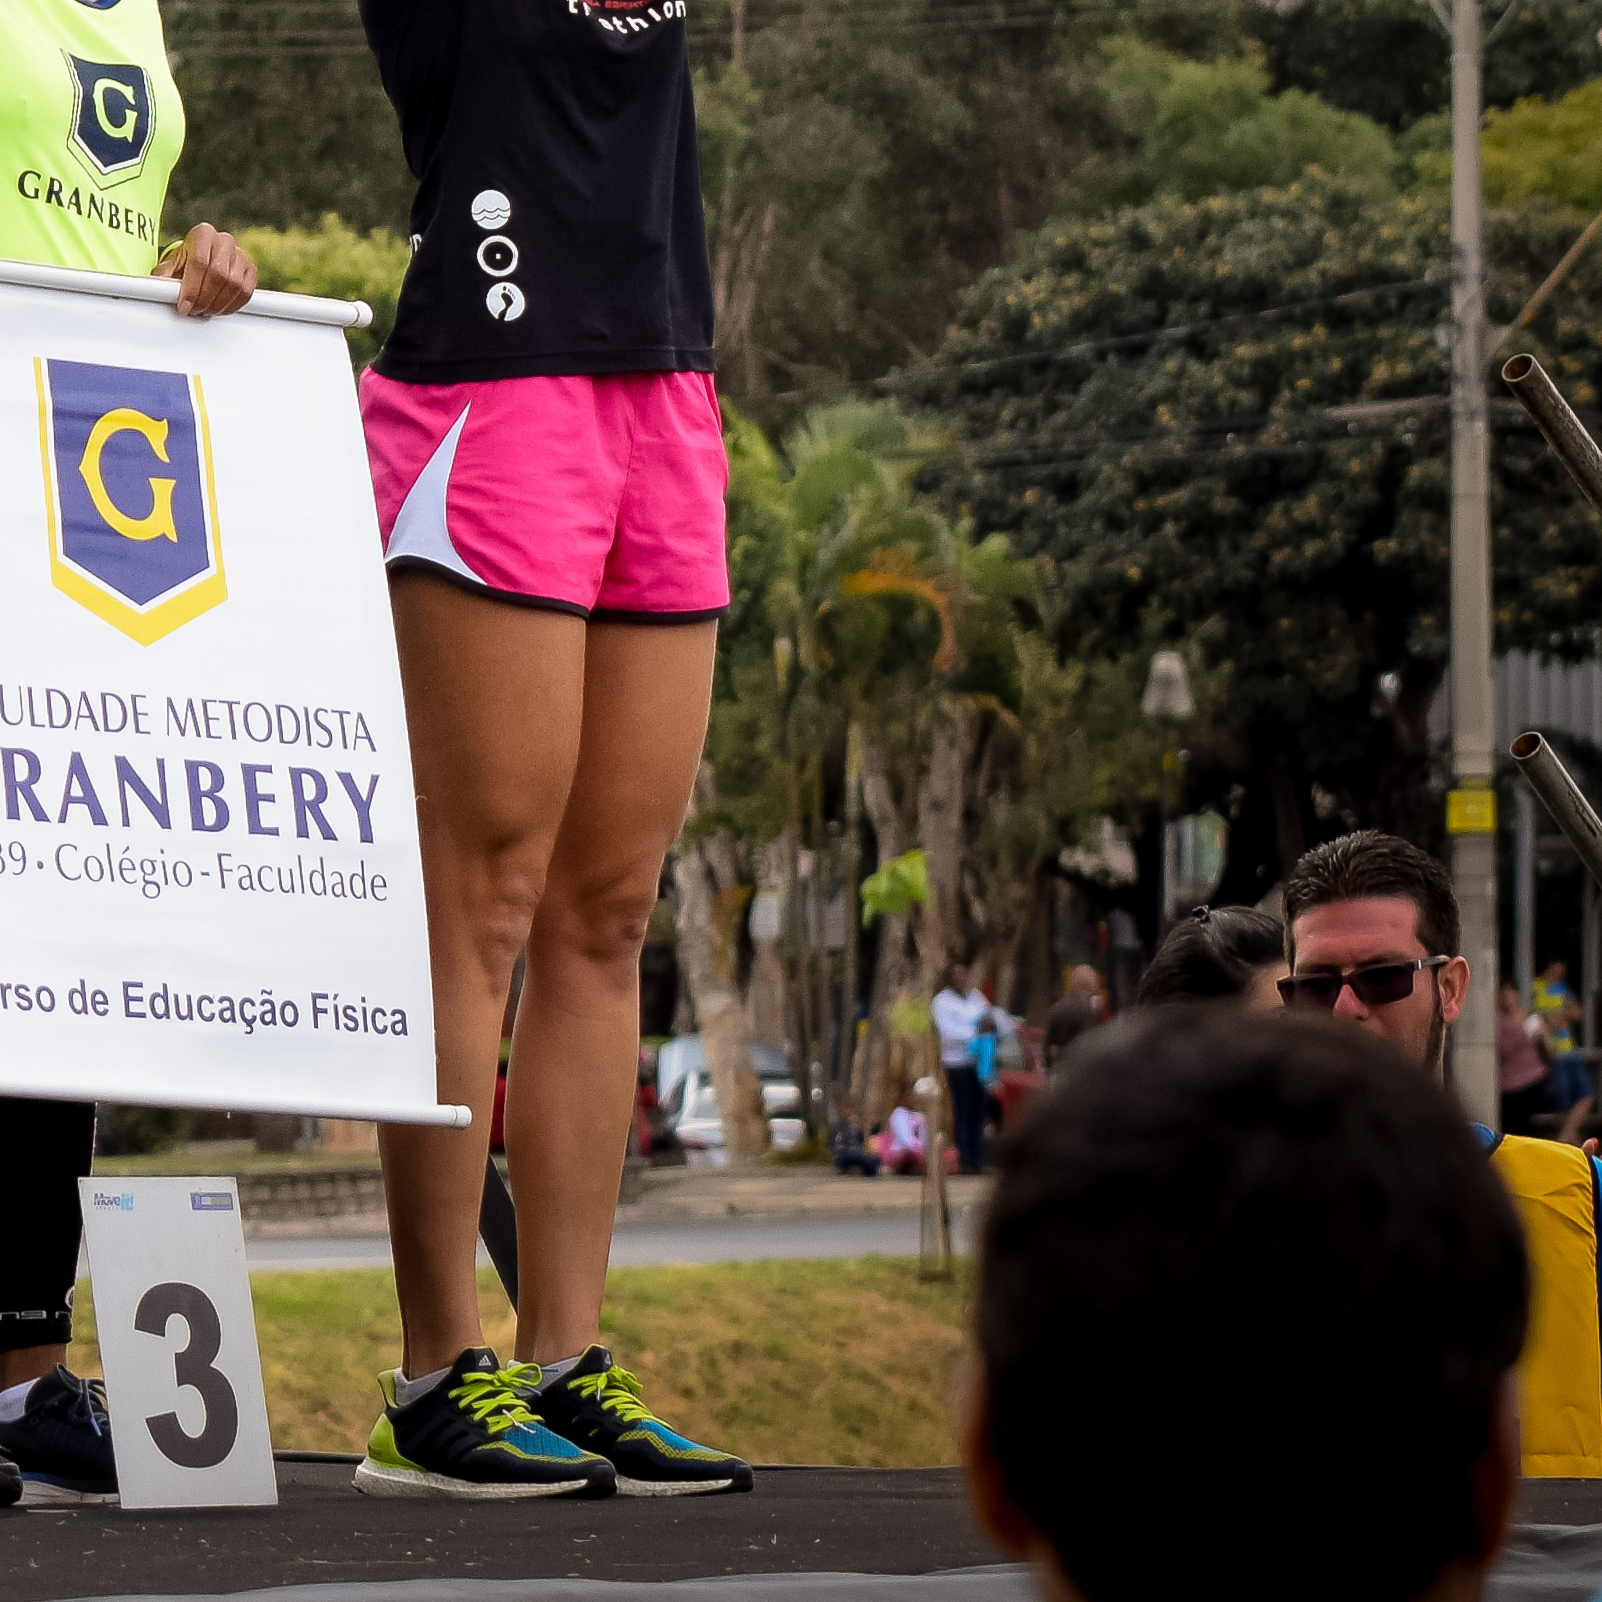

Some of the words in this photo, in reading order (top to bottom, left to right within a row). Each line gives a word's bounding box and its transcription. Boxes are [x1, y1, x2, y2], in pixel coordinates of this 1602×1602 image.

[92, 77, 138, 144] G
[17, 169, 156, 247] GRANBERY
[79, 407, 179, 544] G
[165, 695, 378, 753] METODISTA
[67, 978, 110, 1017] de
[121, 980, 300, 1035] Educação
[310, 991, 410, 1037] Física
[134, 1281, 239, 1469] 3
